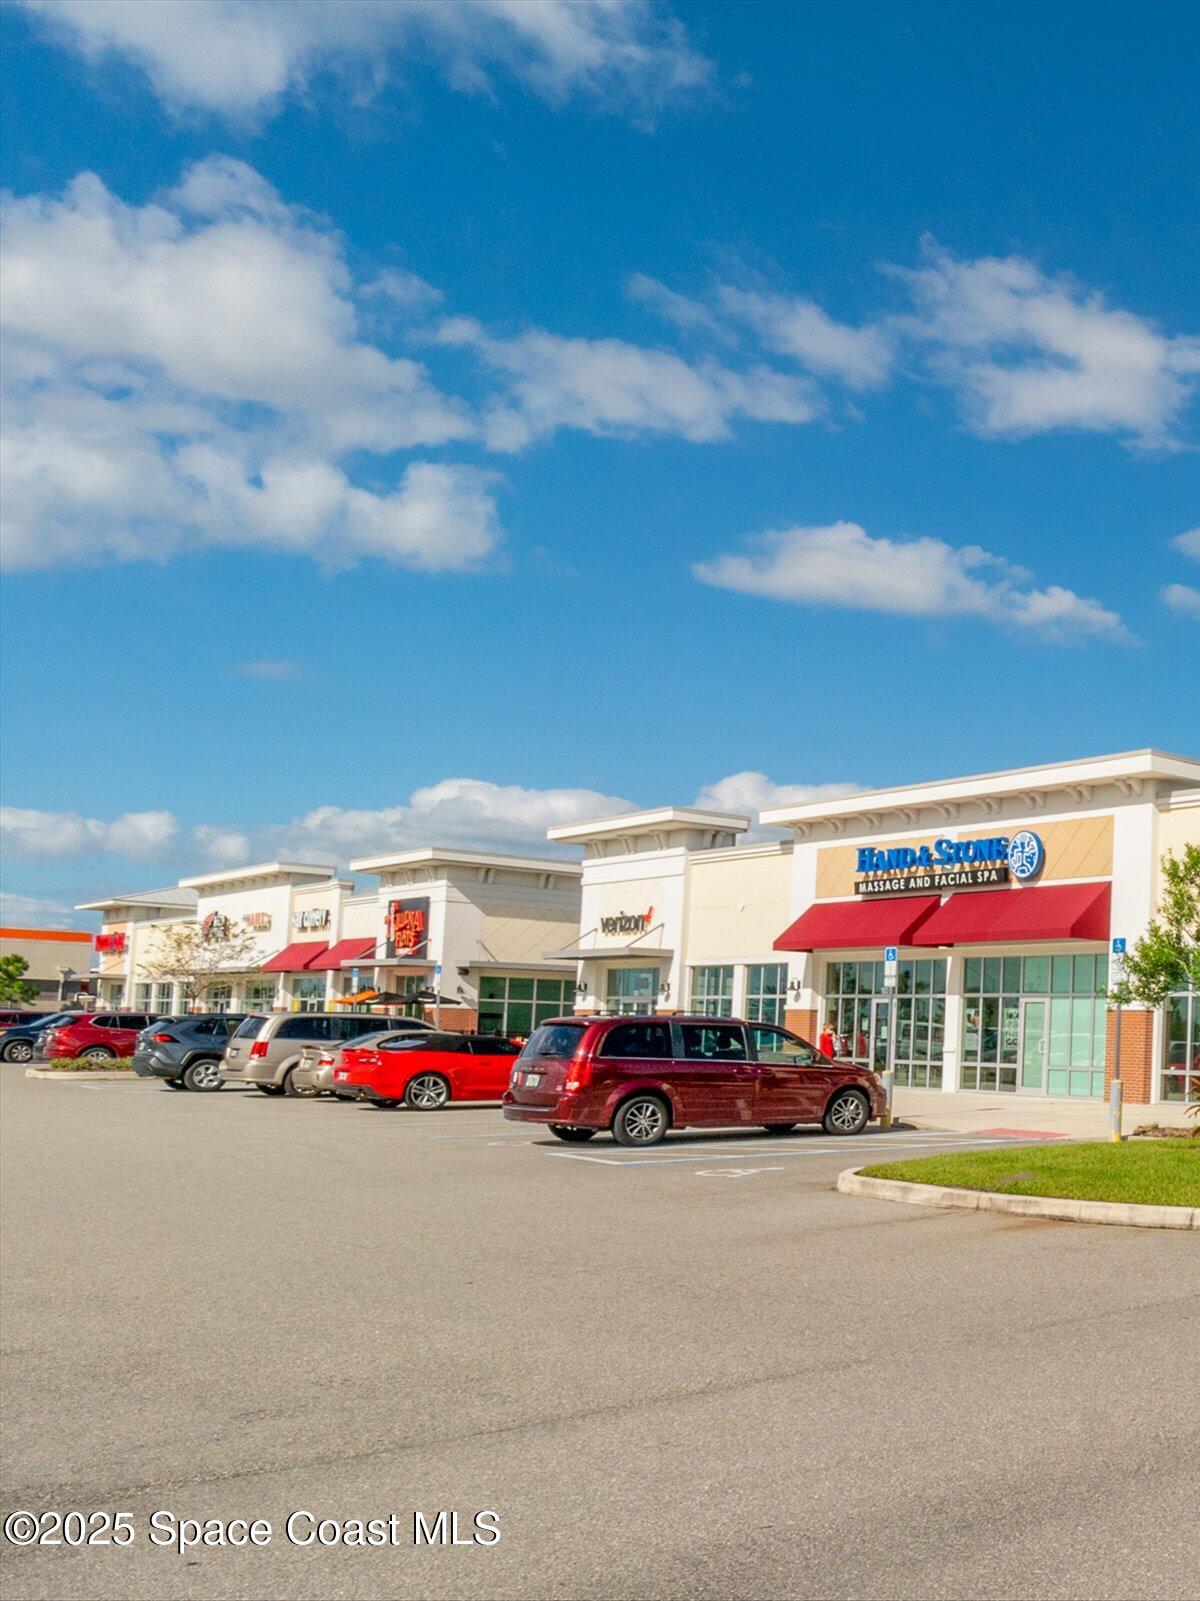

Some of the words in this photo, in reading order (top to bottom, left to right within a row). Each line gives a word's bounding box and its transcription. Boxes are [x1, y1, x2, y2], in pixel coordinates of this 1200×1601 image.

[856, 846, 916, 873] HAND
[934, 837, 1009, 865] STONE
[859, 880, 905, 893] MASSAGE
[909, 877, 931, 888] AND
[935, 872, 973, 887] FACIAL
[977, 869, 998, 882] SPA
[600, 910, 645, 933] verizon
